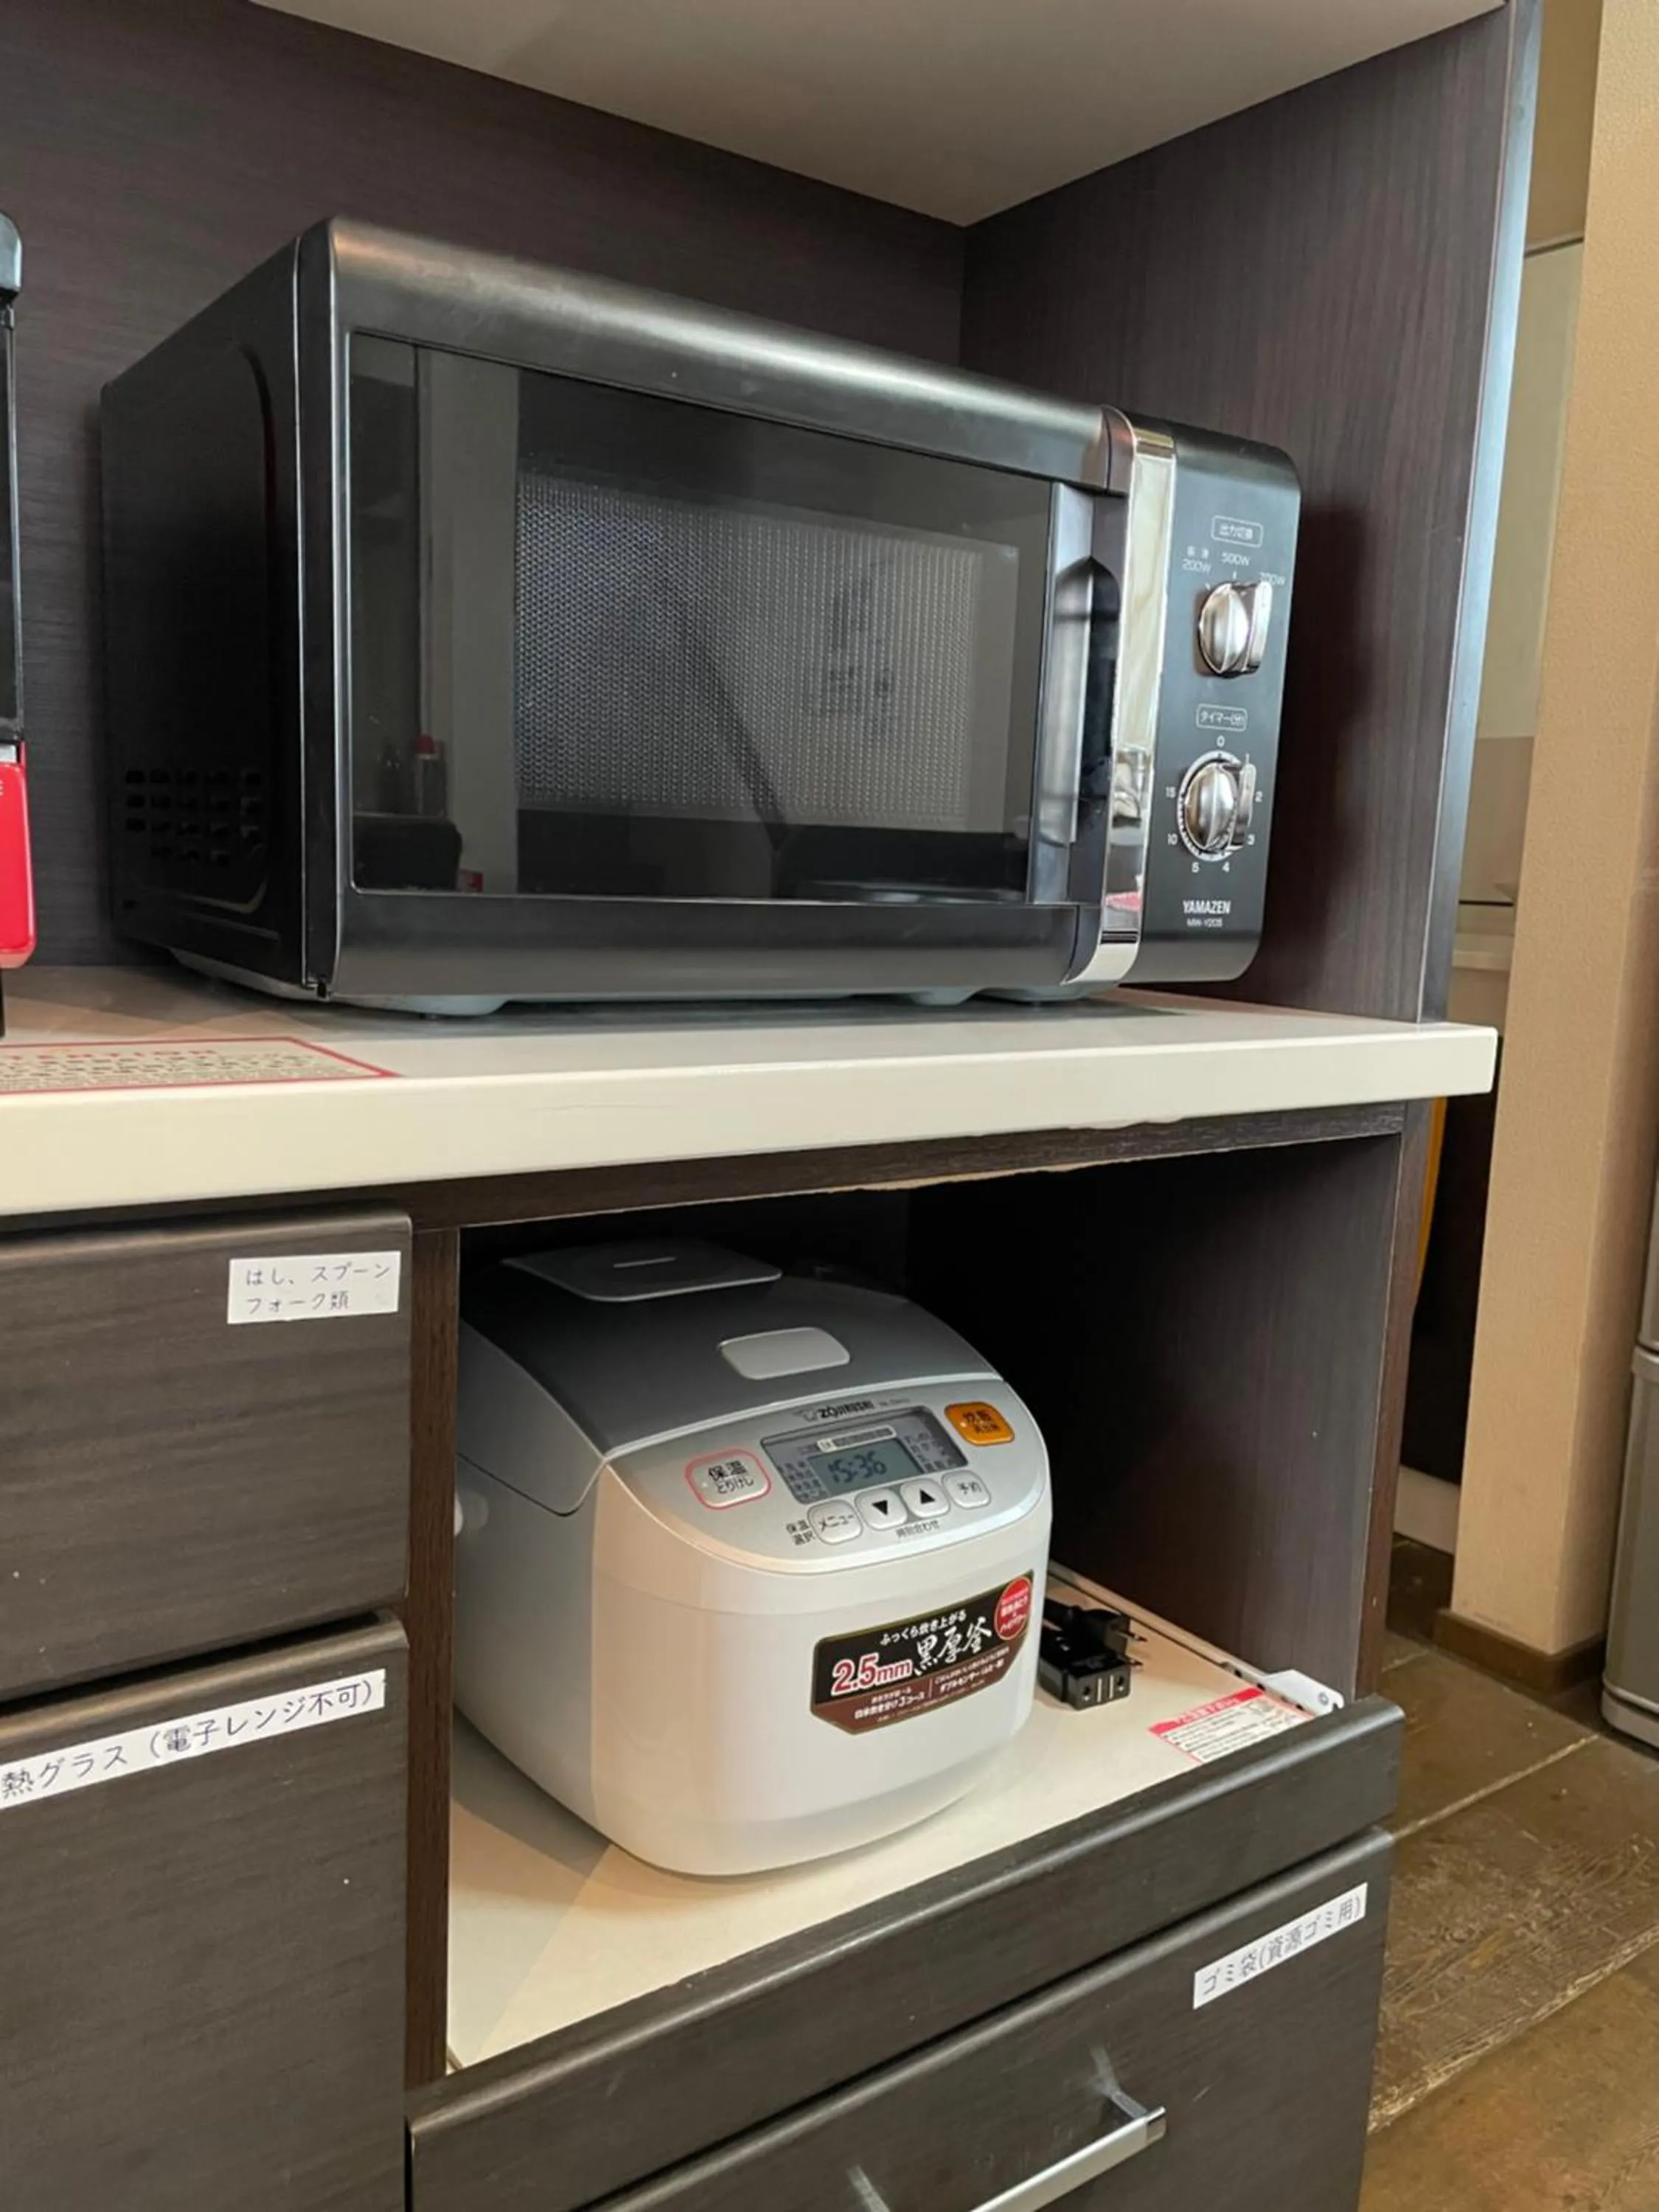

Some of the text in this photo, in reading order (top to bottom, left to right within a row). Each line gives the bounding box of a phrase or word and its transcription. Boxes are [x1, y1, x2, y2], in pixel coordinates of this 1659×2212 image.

[1222, 552, 1251, 566] 500W
[1217, 735, 1225, 748] 0
[1166, 787, 1177, 799] 15
[1255, 790, 1263, 803] 2
[1168, 834, 1178, 846] 10
[1248, 834, 1255, 846] 3
[1222, 862, 1231, 873] 4
[1183, 900, 1231, 914] YAMAZEN
[709, 1461, 748, 1481] 保温
[818, 1514, 855, 1531] メニュー
[831, 1651, 913, 1696] 2.5mm
